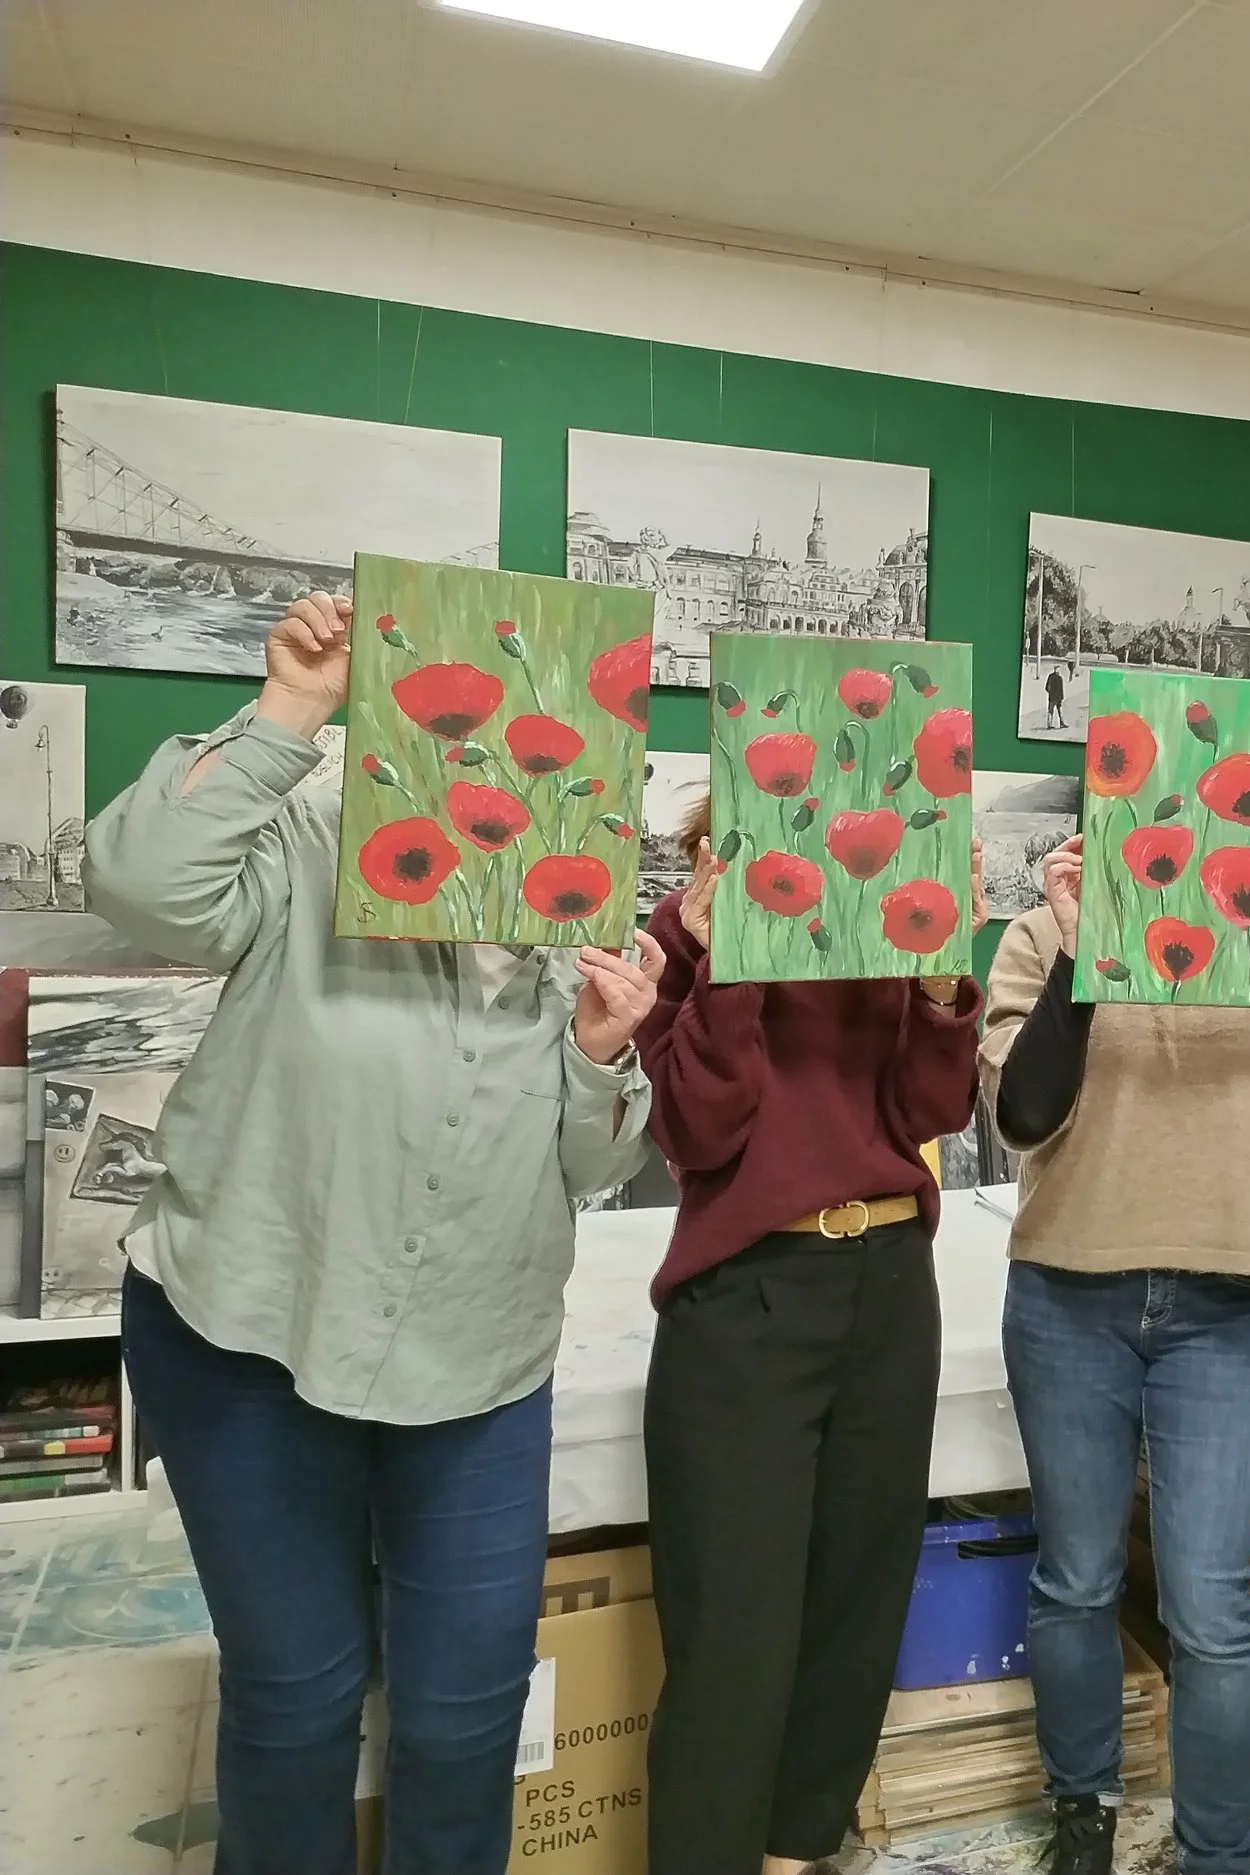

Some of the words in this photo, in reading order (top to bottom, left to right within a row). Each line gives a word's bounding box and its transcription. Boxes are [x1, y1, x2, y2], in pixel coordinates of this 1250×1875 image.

[525, 1780, 575, 1807] PCS
[578, 1787, 643, 1818] CTNS
[522, 1824, 598, 1857] CHINA
